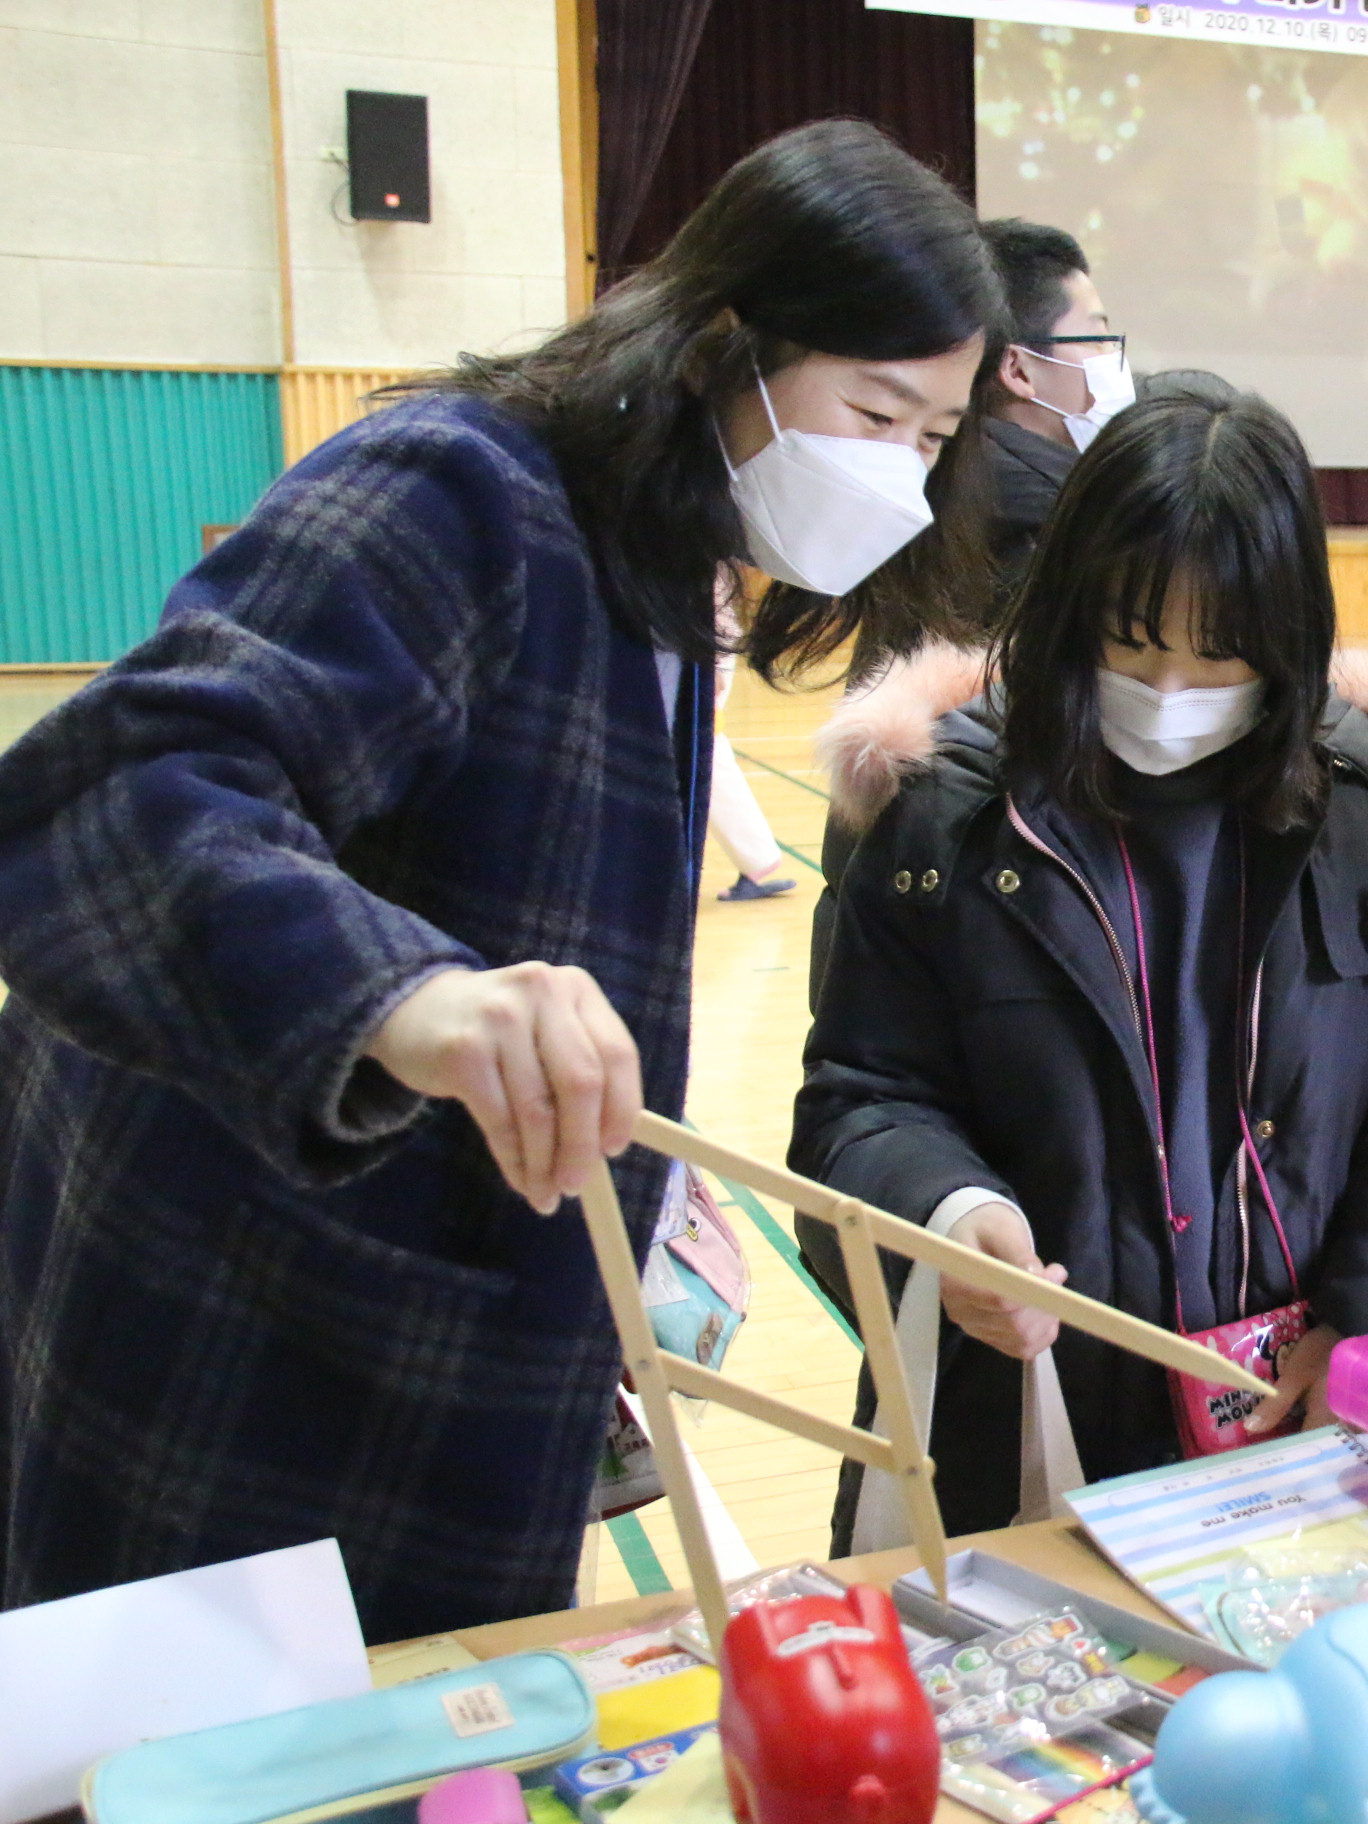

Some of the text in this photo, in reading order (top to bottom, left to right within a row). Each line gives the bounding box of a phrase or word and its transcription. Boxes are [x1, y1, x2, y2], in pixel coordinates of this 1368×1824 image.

[1158, 5, 1191, 28] 일시
[1201, 1494, 1307, 1528] You make me
[1216, 1491, 1272, 1513] SMILE!
